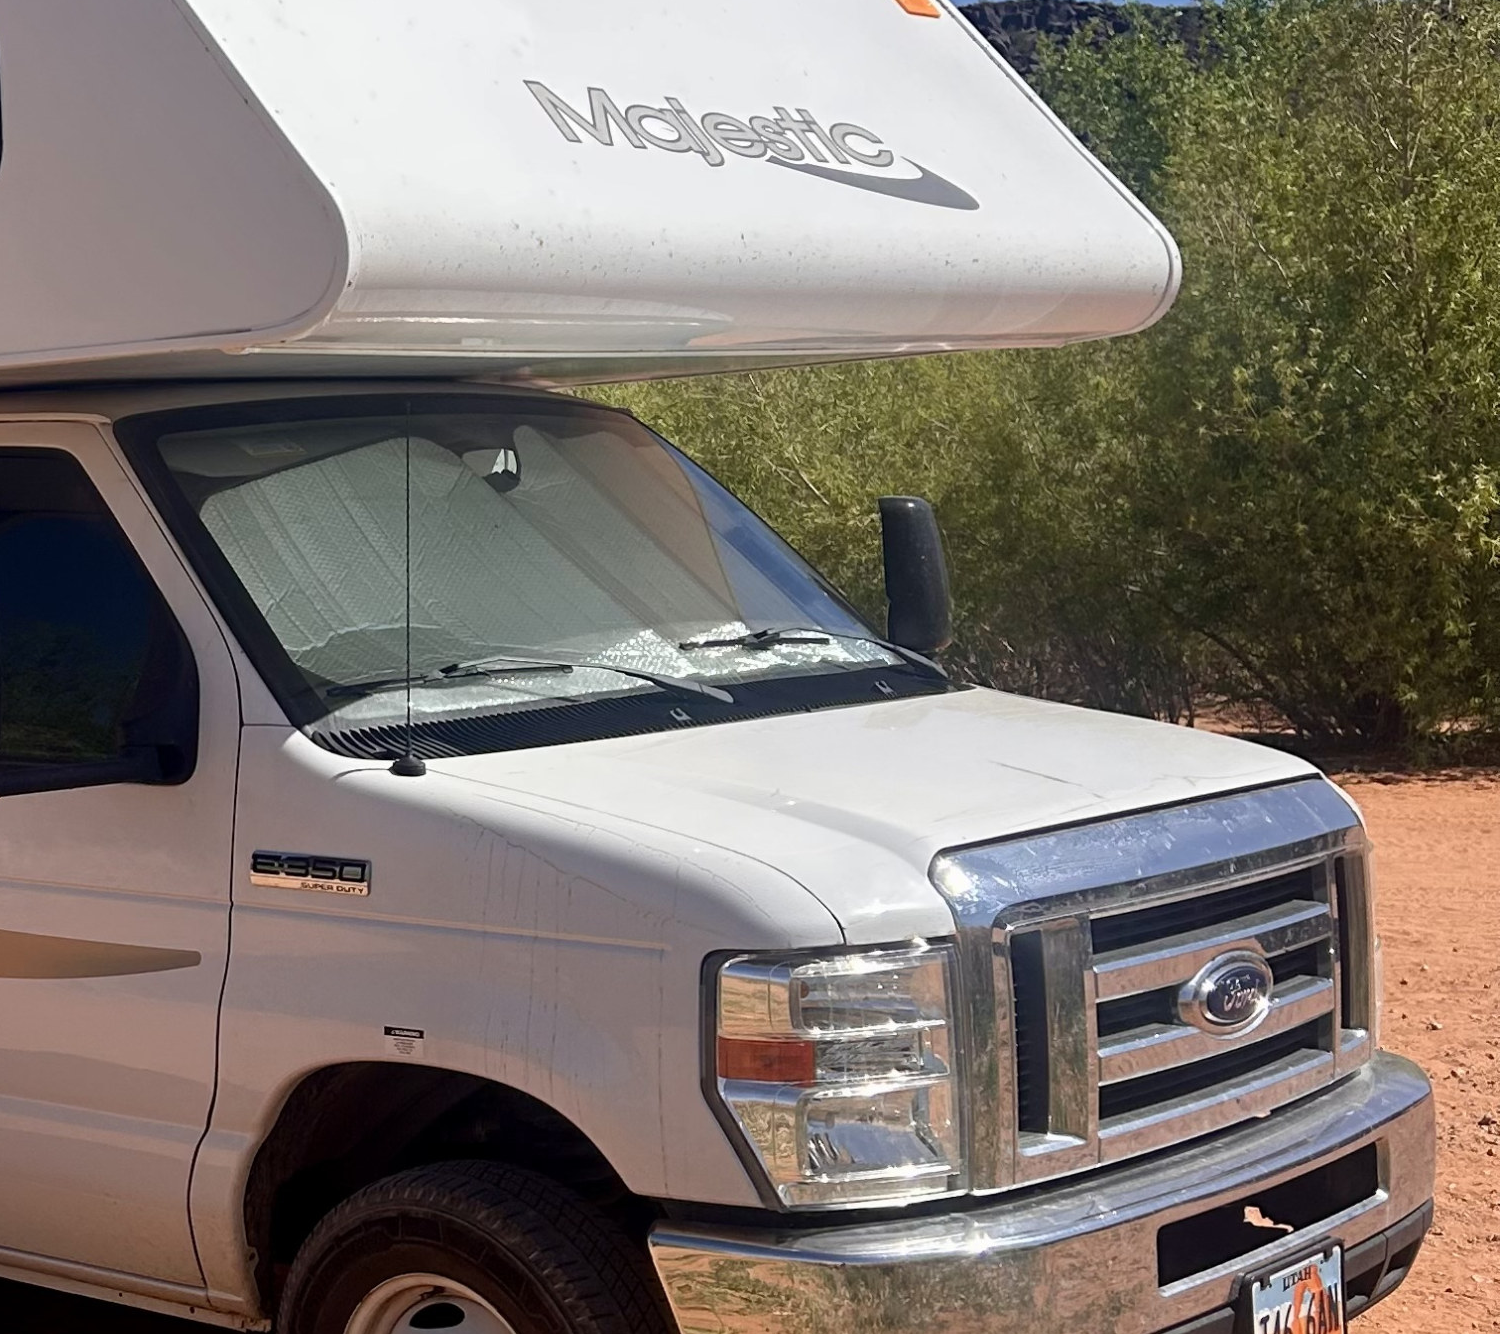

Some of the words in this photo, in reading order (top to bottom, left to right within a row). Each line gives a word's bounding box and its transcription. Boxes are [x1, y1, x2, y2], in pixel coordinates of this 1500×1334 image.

[522, 79, 894, 167] Majestic
[300, 881, 334, 892] SUPER
[336, 885, 364, 895] DUTY
[1221, 976, 1262, 1012] Ford
[1283, 1267, 1312, 1292] UTAH
